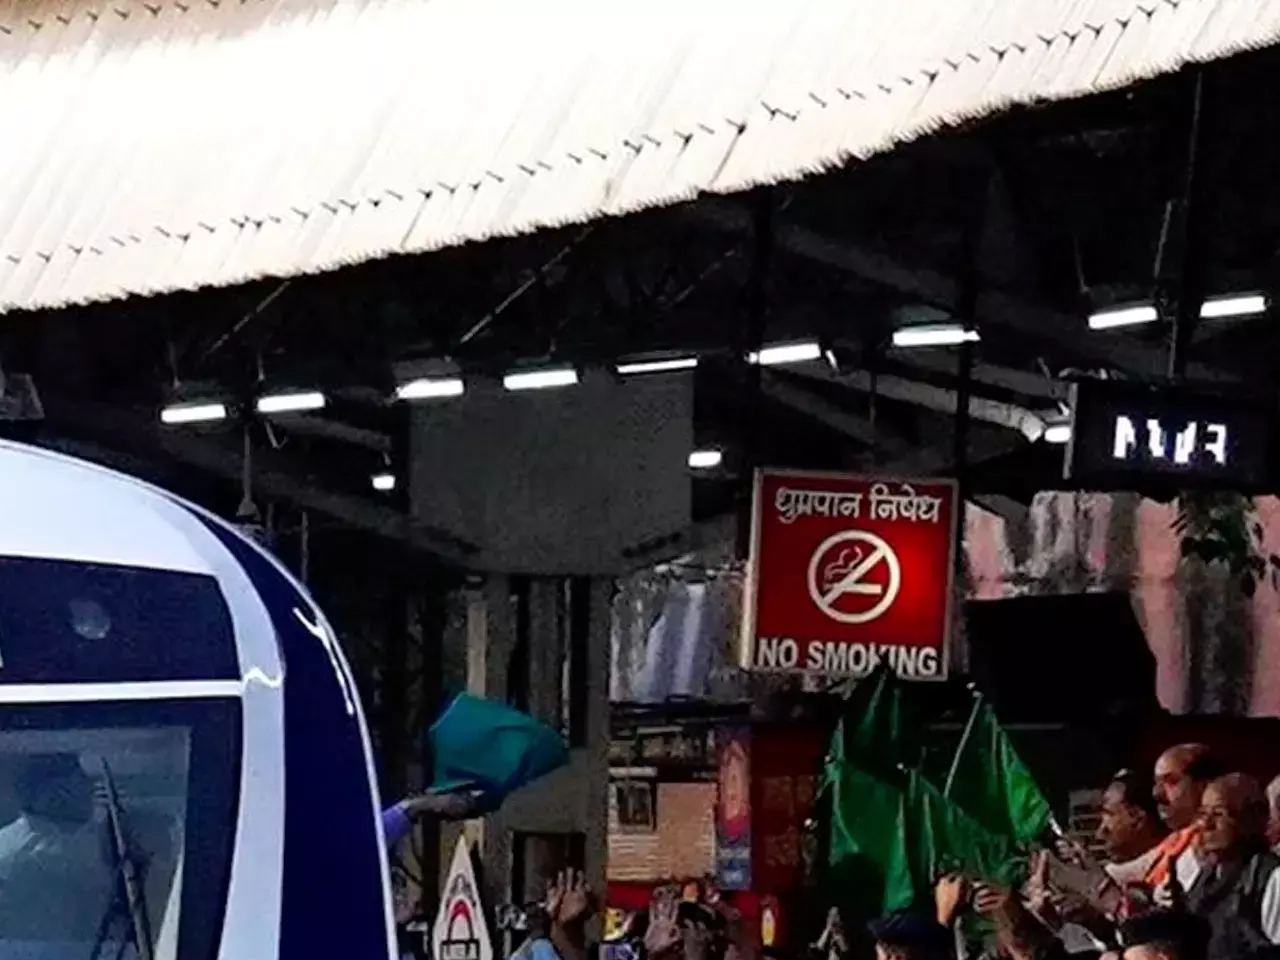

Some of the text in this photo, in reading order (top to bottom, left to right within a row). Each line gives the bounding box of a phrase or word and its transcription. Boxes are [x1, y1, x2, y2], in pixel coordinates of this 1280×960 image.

[869, 483, 943, 523] निषेध
[757, 637, 938, 677] NO SMOKING
